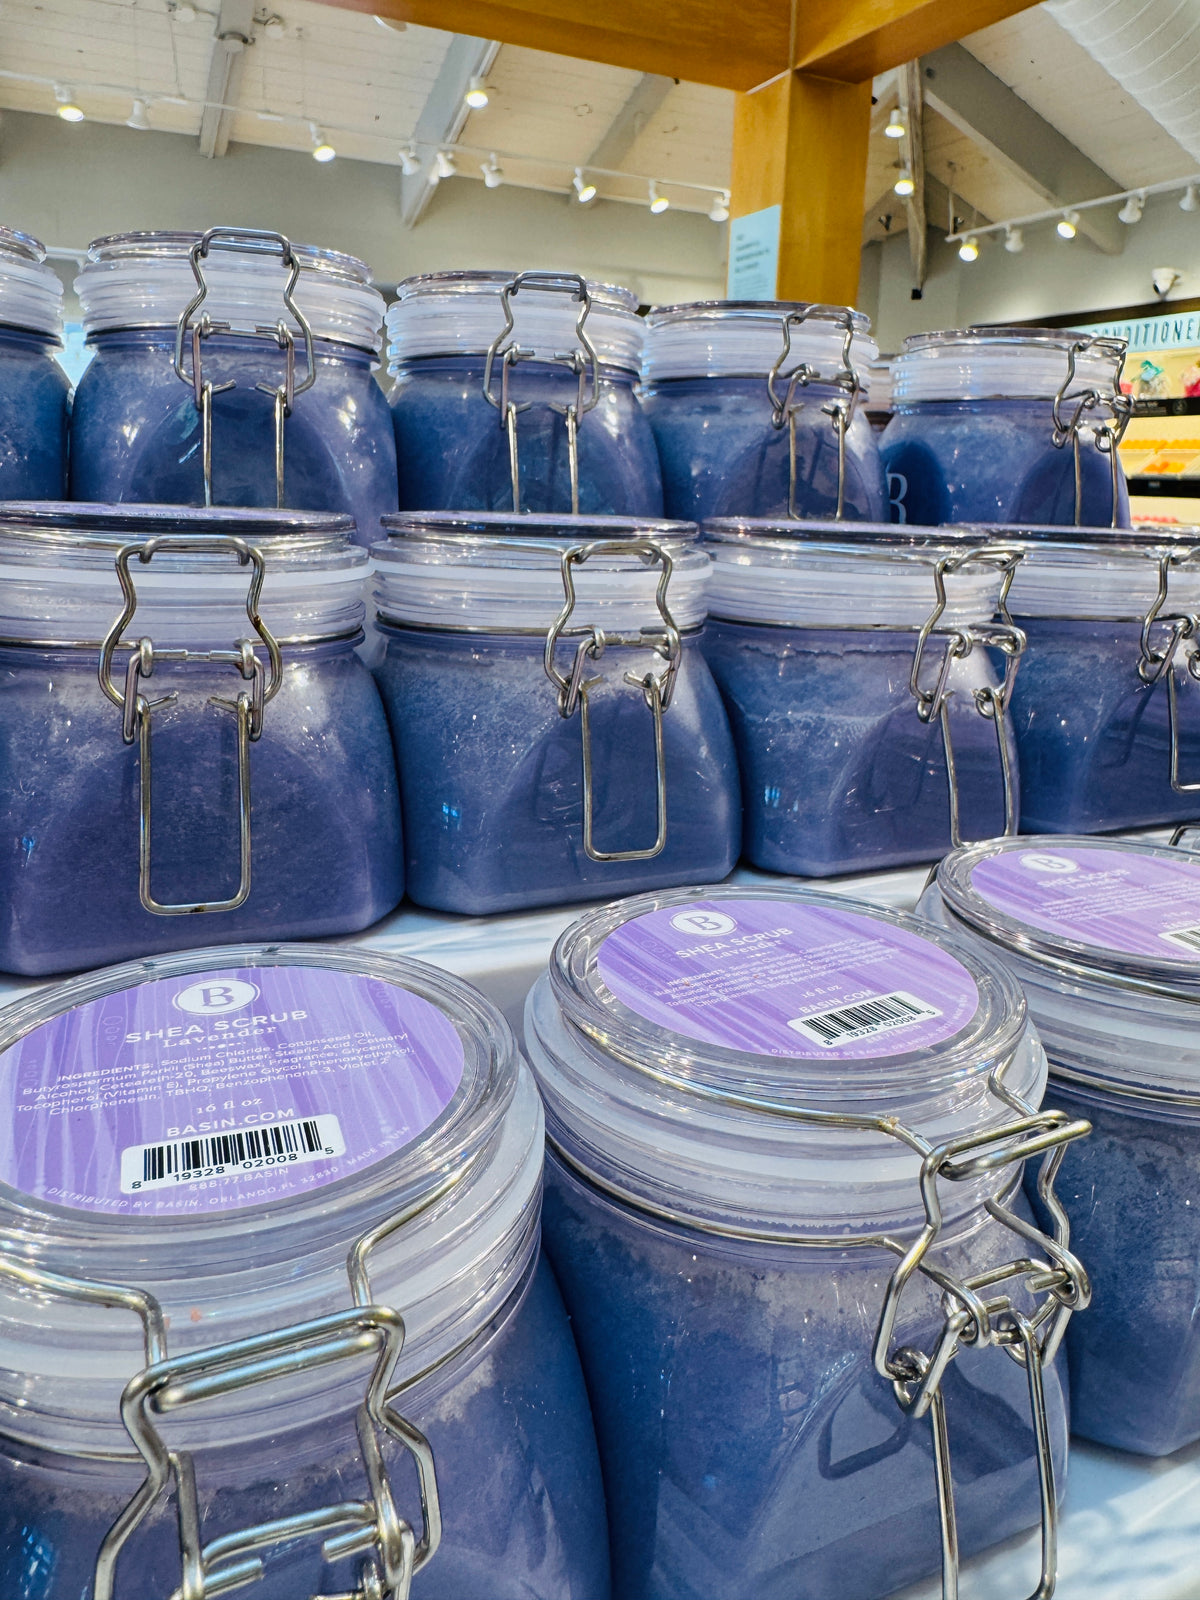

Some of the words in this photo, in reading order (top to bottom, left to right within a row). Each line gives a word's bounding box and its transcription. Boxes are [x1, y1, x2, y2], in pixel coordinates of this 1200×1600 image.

[1092, 318, 1200, 346] DITIONE
[1031, 857, 1067, 870] B
[683, 915, 722, 931] B
[675, 942, 731, 959] SHEA
[730, 927, 793, 946] SCRUB
[709, 939, 784, 959] Lavender
[200, 986, 235, 1007] B
[798, 989, 877, 1014] BASIN.COM
[126, 1024, 204, 1043] SHEA
[214, 1010, 308, 1031] SCRUB
[162, 1026, 277, 1048] Lavender
[23, 1072, 137, 1095] Butyrospermum
[183, 1059, 225, 1072] (Shea)
[275, 1046, 319, 1057] Stearic
[57, 1063, 154, 1082] INGREDIENTS:
[161, 1053, 212, 1066] Sodium
[278, 1033, 350, 1049] Cottonseed
[338, 1060, 378, 1071] Violet
[17, 1094, 100, 1112] Tocopherol
[104, 1084, 161, 1100] (Vitamin
[187, 1070, 257, 1087] Propylene
[35, 1086, 95, 1101] Alcohol,
[197, 1103, 217, 1114] 16
[223, 1100, 236, 1111] fl
[241, 1097, 263, 1107] oz
[166, 1107, 296, 1137] BASIN.COM
[47, 1187, 127, 1208] DISTRIBUTED
[347, 1146, 378, 1166] MADE
[131, 1181, 142, 1190] 8
[173, 1166, 226, 1182] 19328
[242, 1153, 298, 1169] 02008
[324, 1147, 335, 1155] 5
